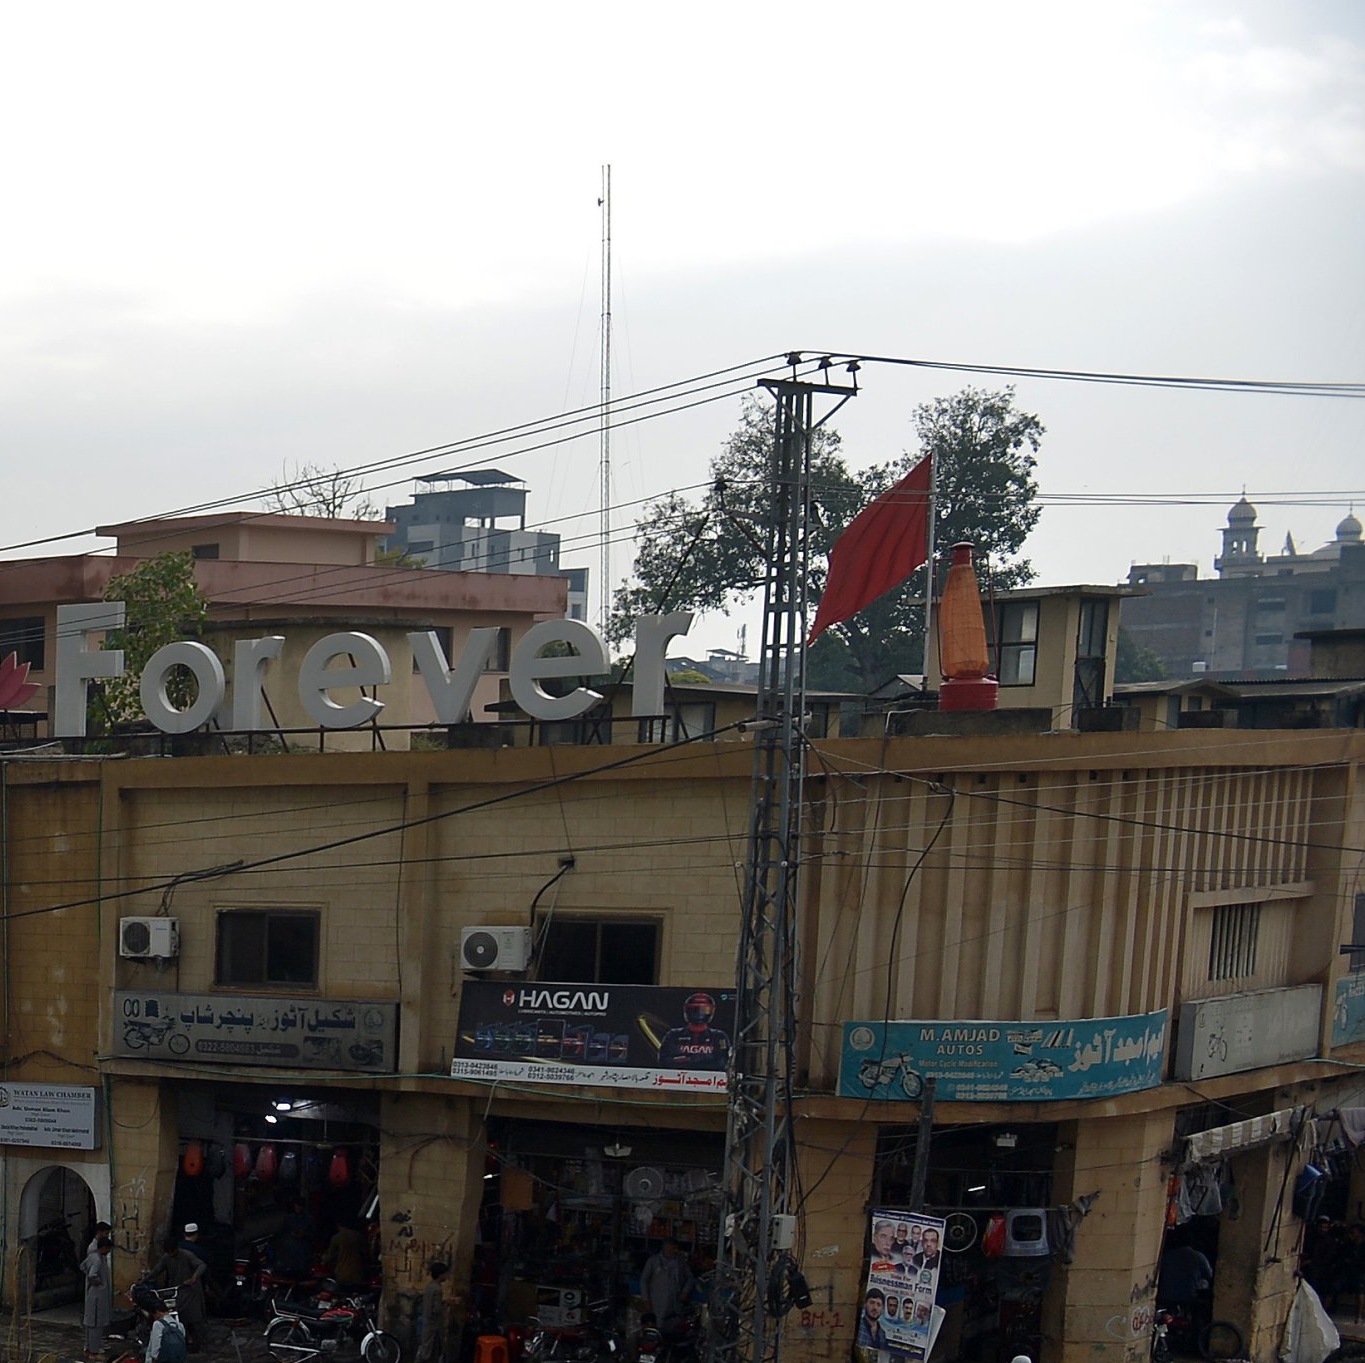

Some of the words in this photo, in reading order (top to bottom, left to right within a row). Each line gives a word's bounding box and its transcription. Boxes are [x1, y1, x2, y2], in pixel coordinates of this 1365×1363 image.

[56, 602, 693, 737] Forever
[519, 989, 610, 1011] HAGAN
[936, 1044, 984, 1056] AUTOS
[13, 1089, 39, 1098] WATAN
[39, 1091, 55, 1099] LAW
[56, 1091, 91, 1099] CHAMBER
